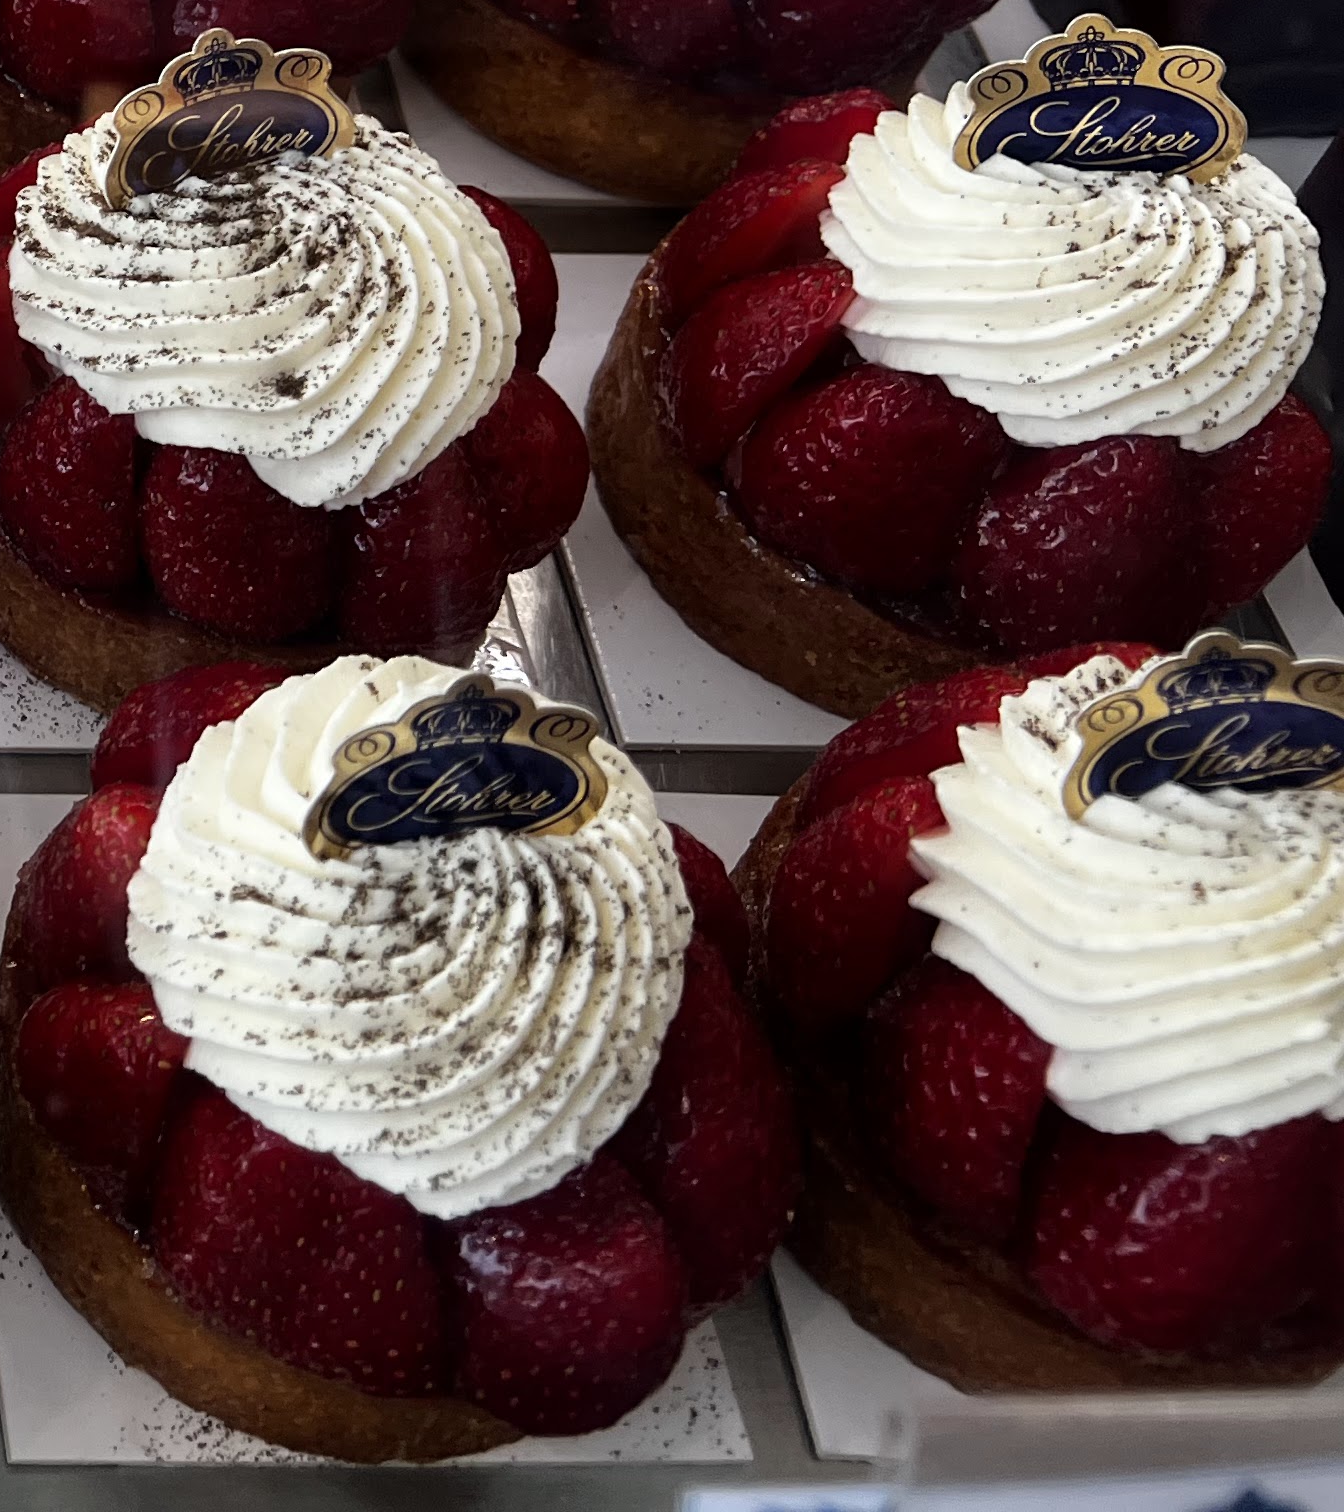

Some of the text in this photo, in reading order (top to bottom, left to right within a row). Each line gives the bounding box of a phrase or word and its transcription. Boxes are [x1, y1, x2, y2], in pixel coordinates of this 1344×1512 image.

[142, 104, 314, 188] Stohrer
[996, 96, 1200, 164] Stohrer
[1109, 713, 1342, 792] Stohrer
[346, 754, 556, 832] Stohrer
